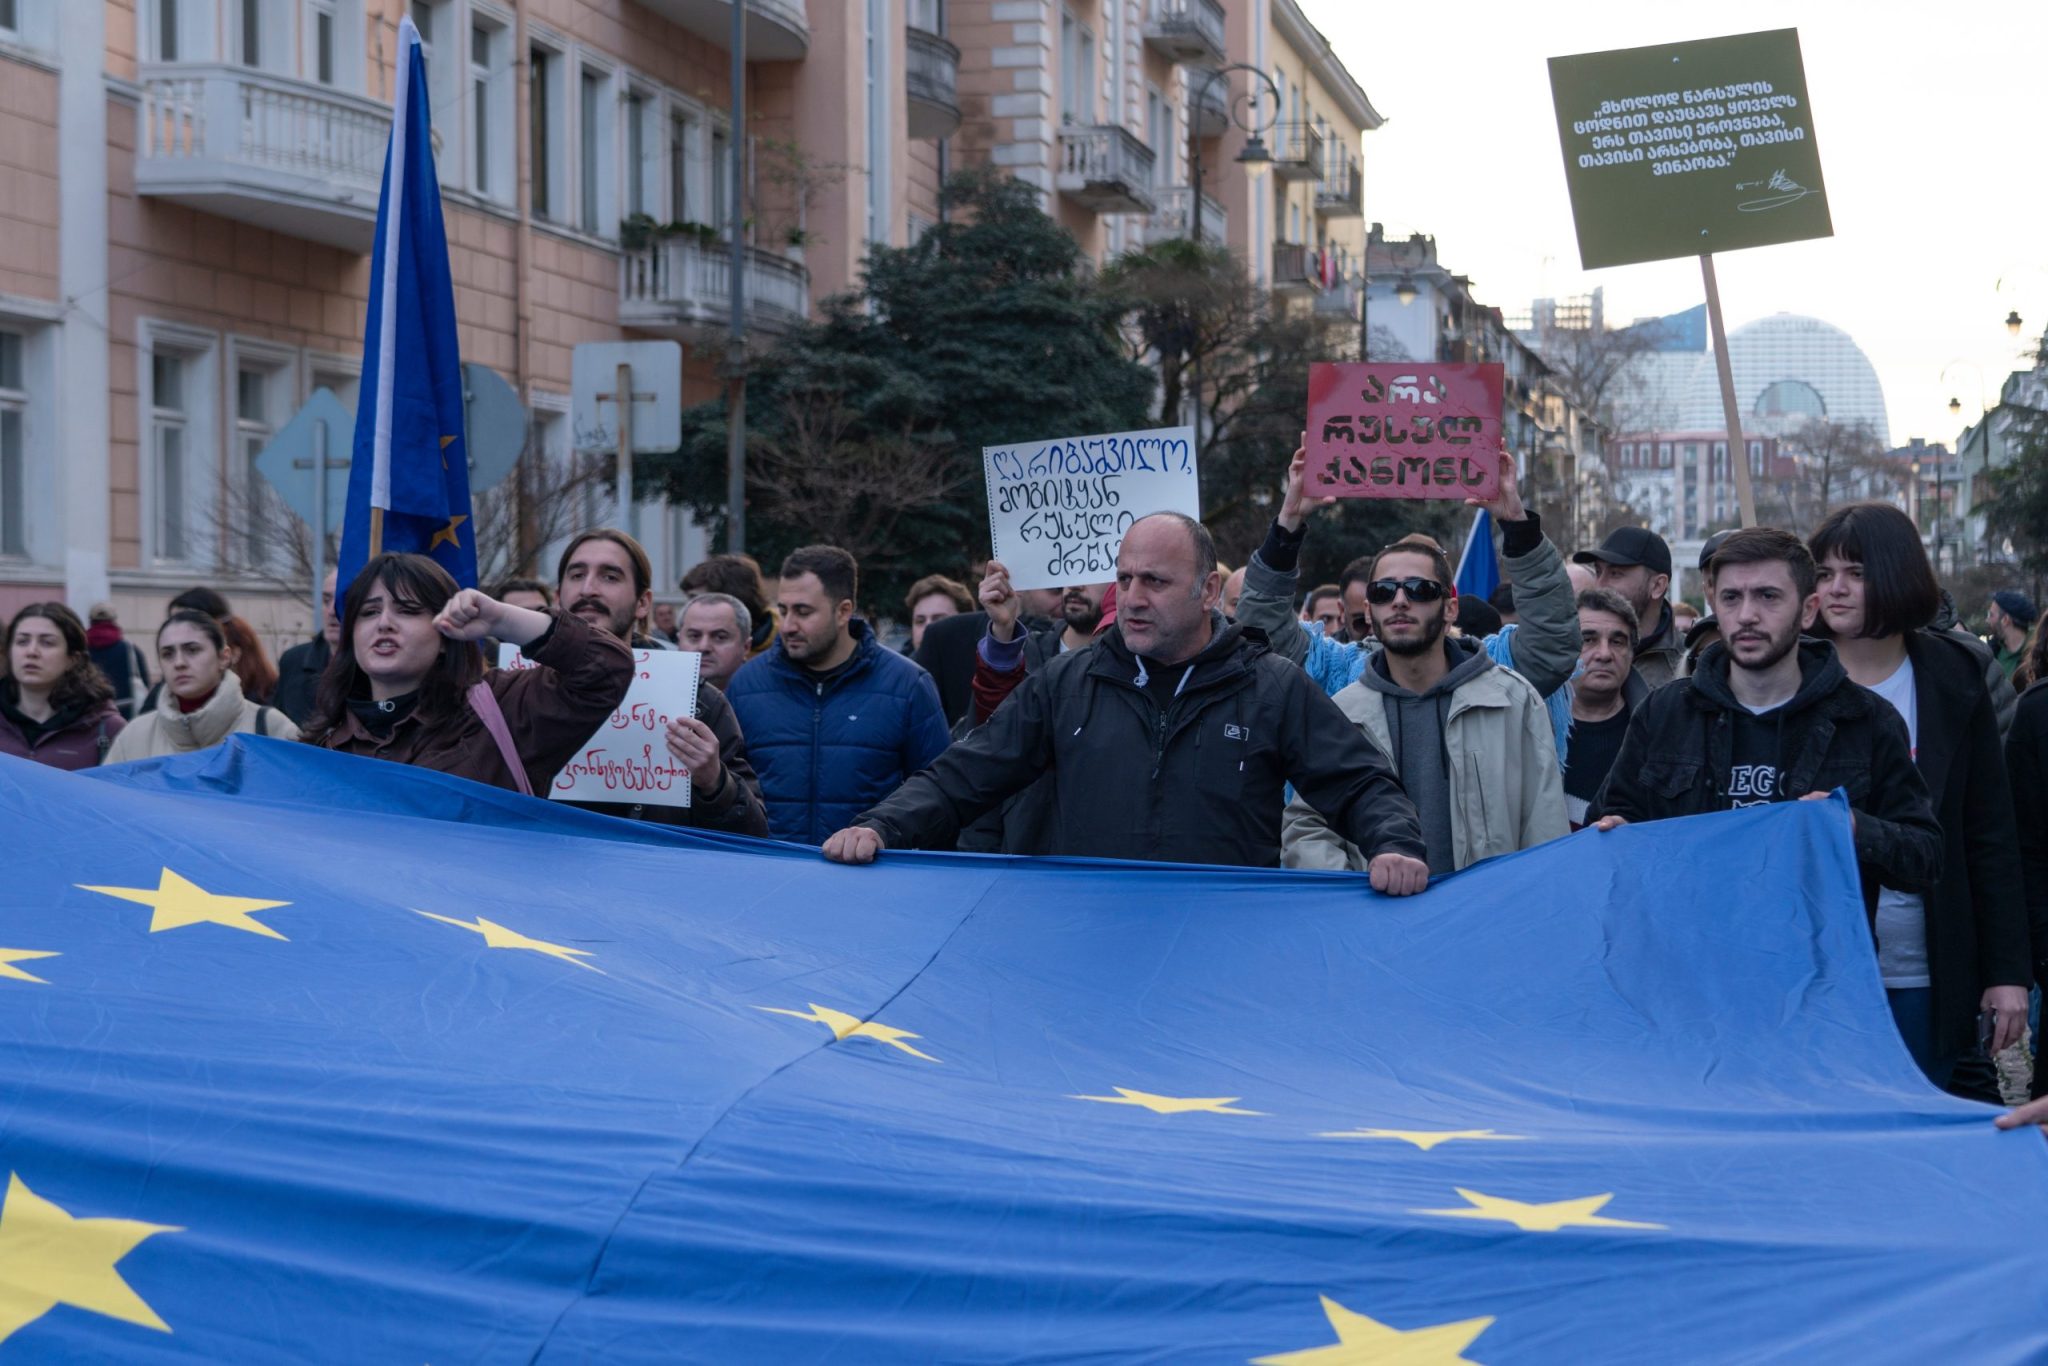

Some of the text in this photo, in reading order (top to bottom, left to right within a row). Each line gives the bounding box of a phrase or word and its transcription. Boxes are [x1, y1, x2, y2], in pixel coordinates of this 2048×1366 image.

[1683, 81, 1773, 103] წარსულის
[1574, 96, 1797, 134] ცოდნით დაუცავს ყოველს
[1578, 127, 1804, 168] თავისი არსებობა, თავისი
[1592, 114, 1785, 150] ერს თავისი ეროვნება,
[1361, 374, 1448, 405] არა
[1322, 415, 1482, 444] რუსულ
[993, 438, 1192, 481] ღარიბაშვილო,
[1317, 456, 1485, 486] კანონს
[1020, 510, 1135, 543] რუსული
